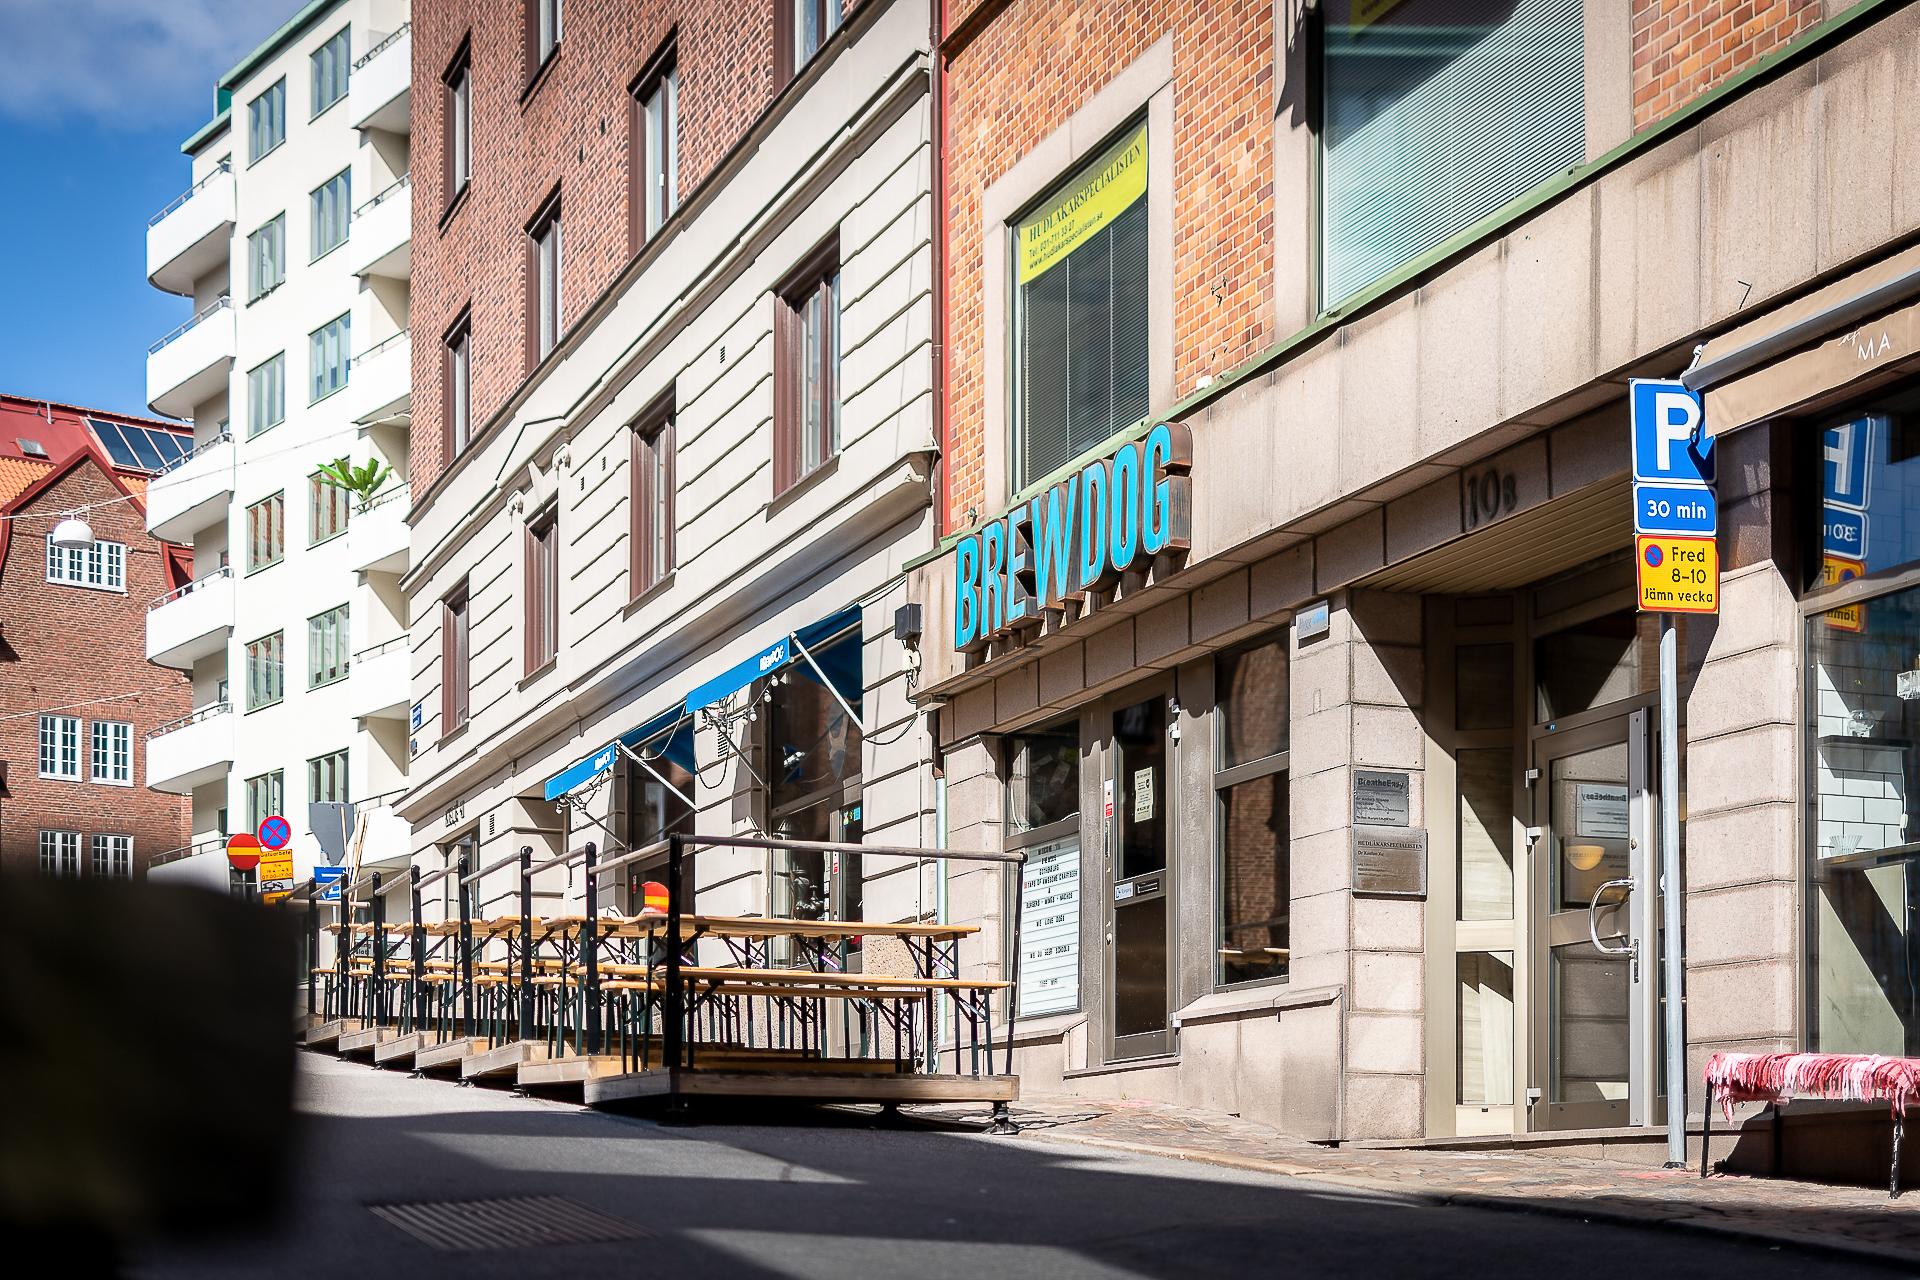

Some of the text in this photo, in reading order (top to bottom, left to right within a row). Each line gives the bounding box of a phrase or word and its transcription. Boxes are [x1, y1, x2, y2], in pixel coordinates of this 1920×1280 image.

[1656, 392, 1700, 471] P
[1647, 499, 1707, 520] 30 min
[955, 422, 1191, 653] BREWDOG
[1672, 546, 1706, 563] Fred
[1644, 587, 1713, 603] Jämn vecka
